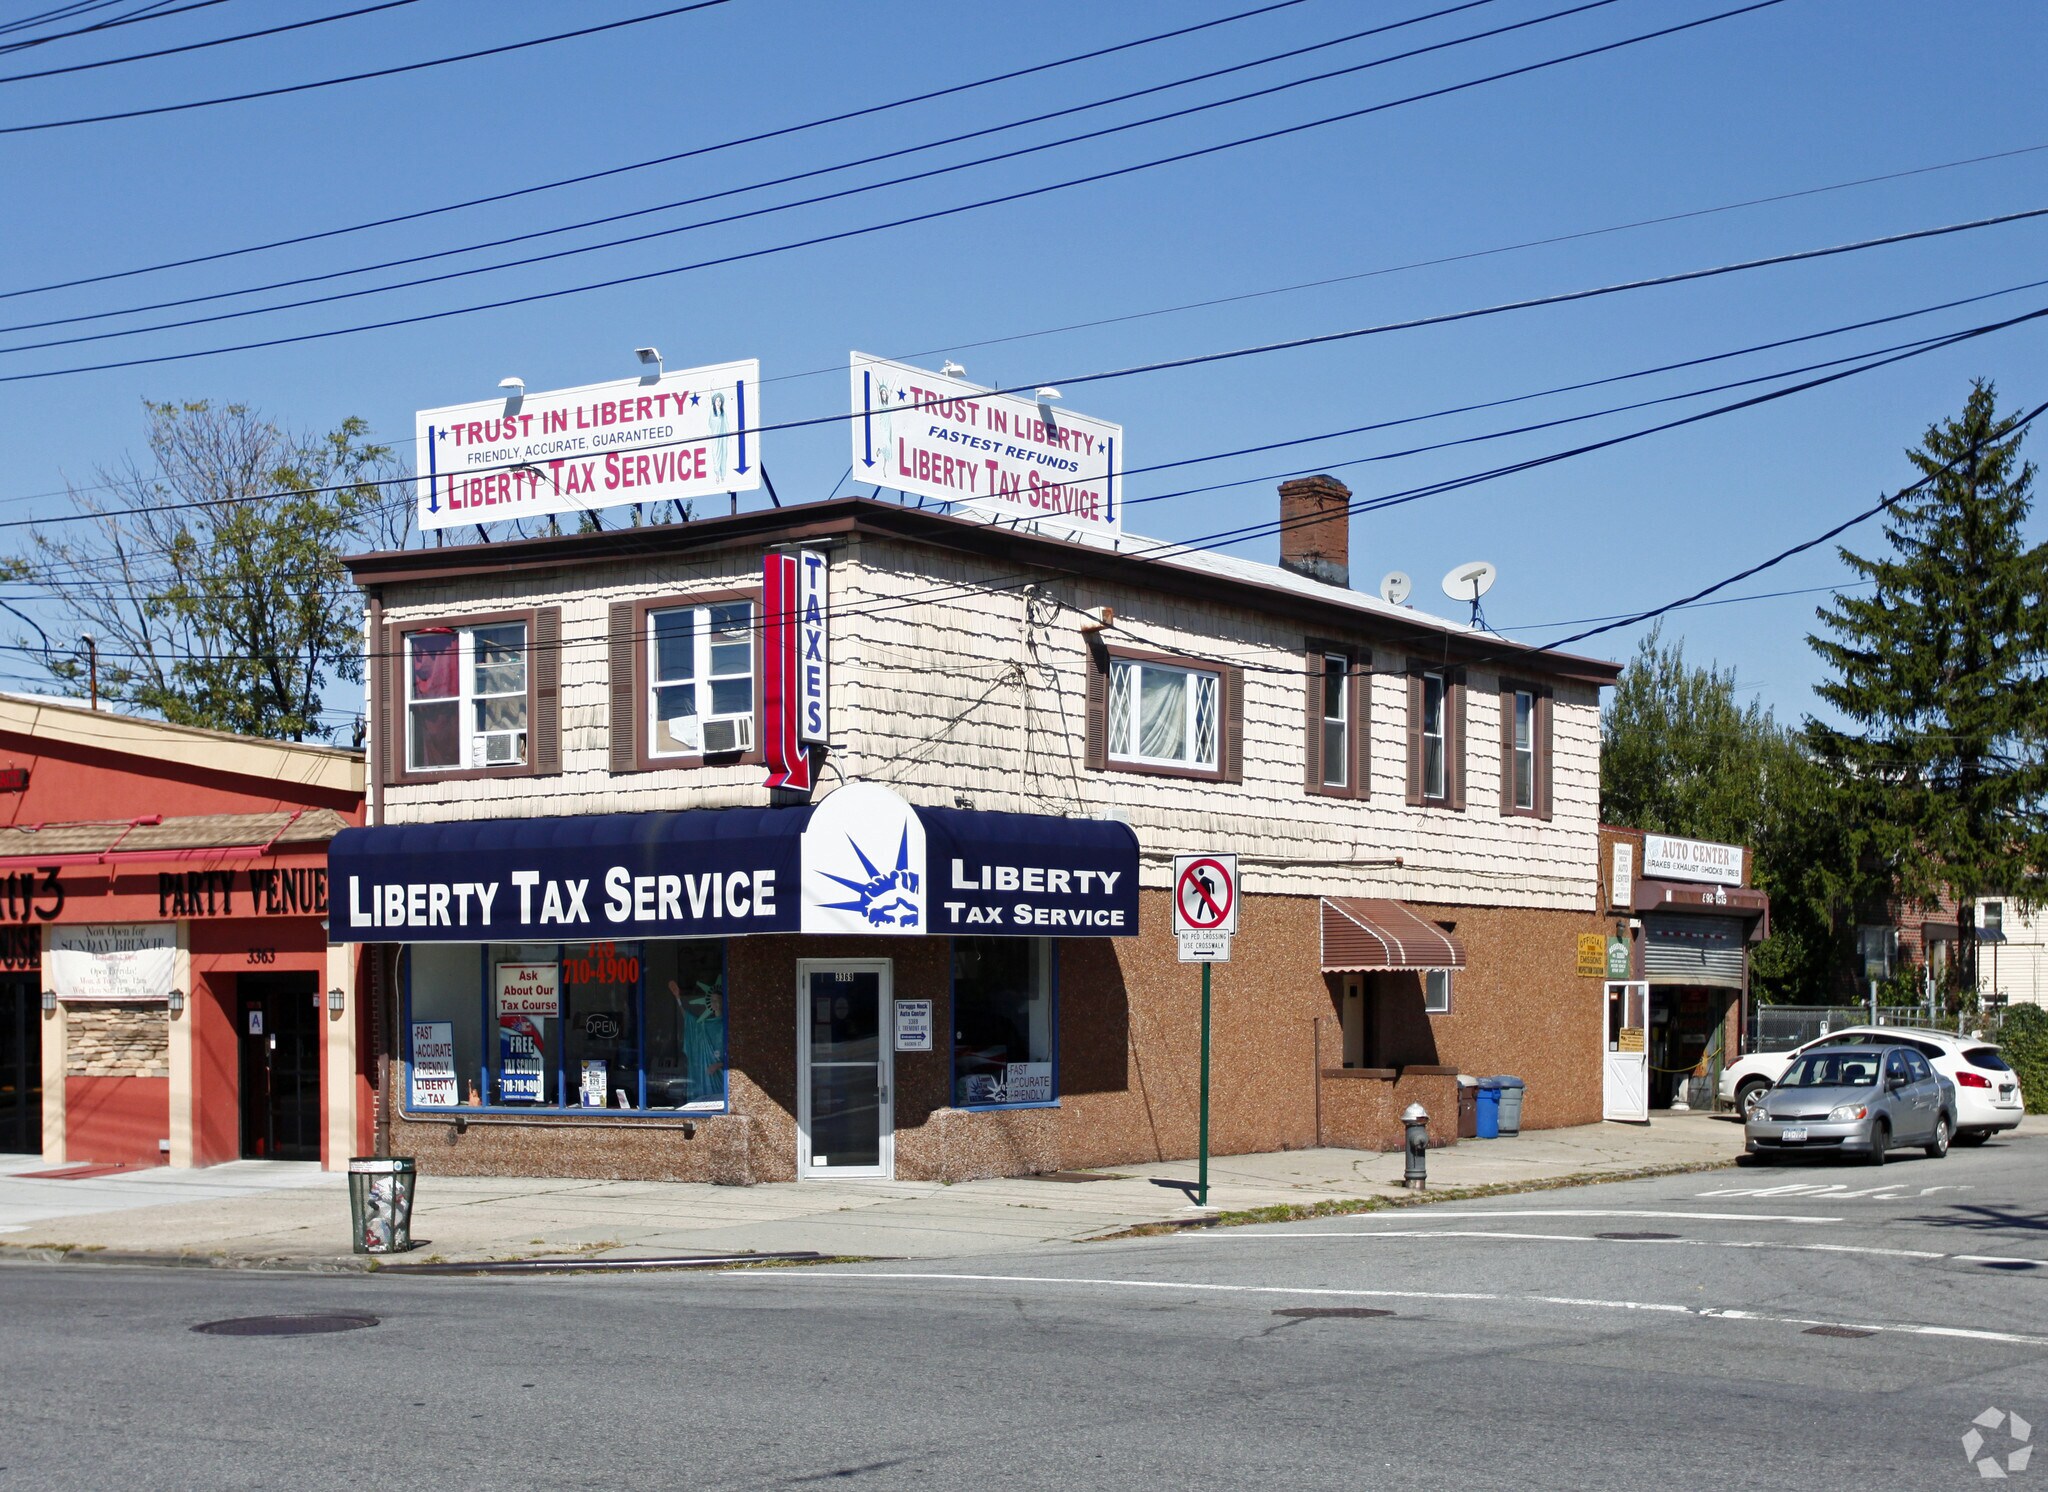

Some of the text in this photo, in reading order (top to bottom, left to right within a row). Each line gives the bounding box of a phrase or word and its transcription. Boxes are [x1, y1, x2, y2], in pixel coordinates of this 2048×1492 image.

[451, 391, 689, 446] TRUST IN LIBERTY
[910, 386, 1094, 456] TRUST IN LIBERTY
[468, 426, 673, 465] FRIENDLY, ACCURATE, GUARANTEED
[928, 426, 1079, 472] FASTEST REFUNDS
[448, 448, 707, 510] LIBERTY TAX SERVICE
[899, 437, 1099, 522] LIBERTY TAX SERVICE
[805, 557, 822, 734] TAXES
[1662, 840, 1688, 860] AUTO
[1693, 844, 1730, 866] CENTER
[1648, 859, 1670, 869] BRAKES
[1673, 862, 1699, 872] EXHAUST
[1701, 866, 1722, 876] SHOCKS
[952, 858, 1122, 895] LIBERTY
[159, 869, 237, 917] PARTY
[248, 867, 328, 915] VENUE
[349, 866, 776, 927] LIBERTY TAX SERVICE
[944, 902, 1125, 926] TAX SERVICE
[86, 925, 146, 940] Now Open for
[62, 938, 112, 952] SUNDAY
[1580, 936, 1602, 950] OFFICIAL
[247, 948, 276, 964] 3363
[518, 970, 538, 981] Ask
[562, 957, 639, 984] 710-4900
[836, 972, 854, 981] 3369
[504, 985, 554, 996] About Our
[501, 1000, 557, 1010] Tax Course
[252, 1014, 260, 1028] A
[586, 1021, 618, 1033] OPEN
[415, 1026, 432, 1040] -FAST
[415, 1043, 452, 1058] -ACCURATE
[510, 1036, 534, 1053] FREE
[504, 1058, 540, 1075] TAX SCHOOL
[416, 1080, 454, 1090] LIBERTY
[428, 1093, 446, 1104] TAX
